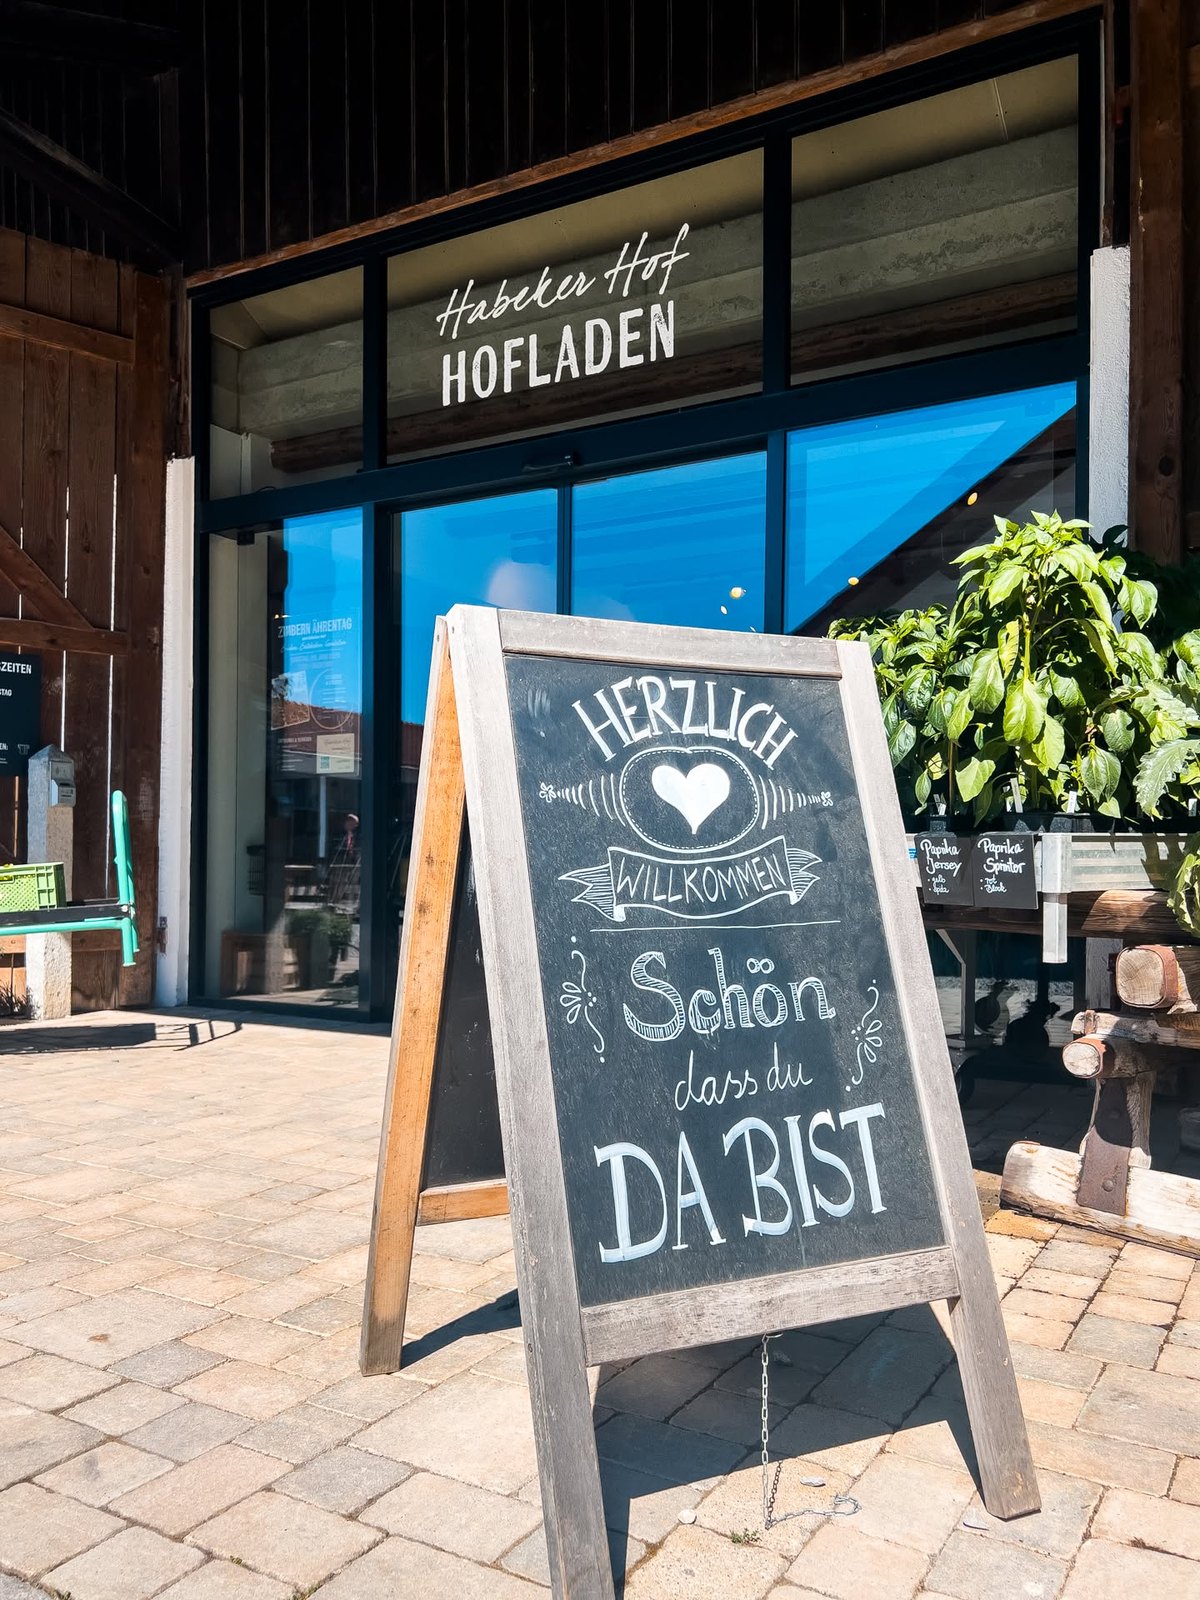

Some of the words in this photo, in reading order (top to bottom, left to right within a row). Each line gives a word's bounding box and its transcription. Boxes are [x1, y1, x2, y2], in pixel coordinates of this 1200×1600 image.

[436, 266, 596, 339] Habeker
[604, 223, 690, 297] Hof
[442, 300, 674, 406] HOFLADEN
[312, 617, 353, 634] ÄHRENTAG
[0, 661, 32, 674] ZEITEN
[572, 676, 798, 770] HERZLICH
[920, 838, 961, 860] Paprika
[926, 857, 962, 877] Jersey
[978, 838, 1024, 859] Paprika
[617, 854, 786, 903] WILLKOMMEN
[623, 947, 836, 1042] Schön
[675, 1050, 757, 1111] dass
[767, 1042, 813, 1092] du
[593, 1131, 726, 1263] DA
[722, 1102, 887, 1237] BIST
